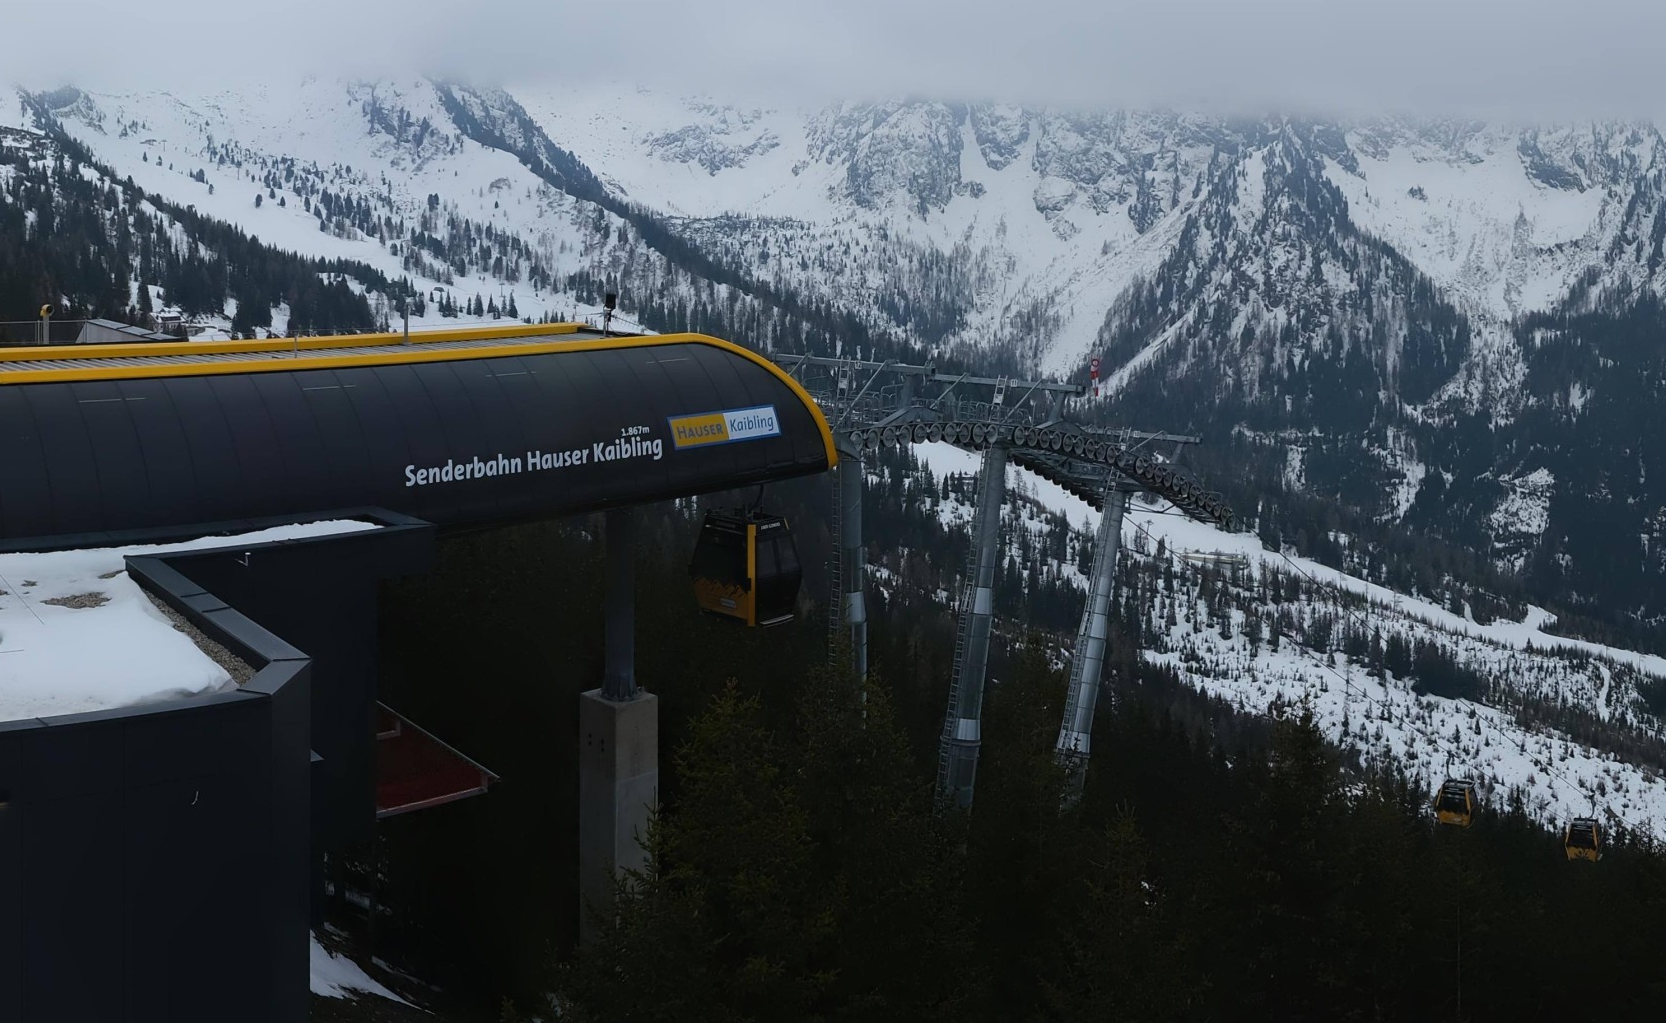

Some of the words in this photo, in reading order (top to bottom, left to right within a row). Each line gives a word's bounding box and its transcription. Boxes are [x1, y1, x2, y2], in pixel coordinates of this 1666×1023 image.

[620, 425, 650, 437] 1.867m
[676, 421, 724, 440] HAUSER
[729, 413, 774, 433] Kaibling
[404, 453, 522, 487] Senderbahn
[527, 446, 589, 473] Hauser
[593, 436, 663, 462] Kaibling
